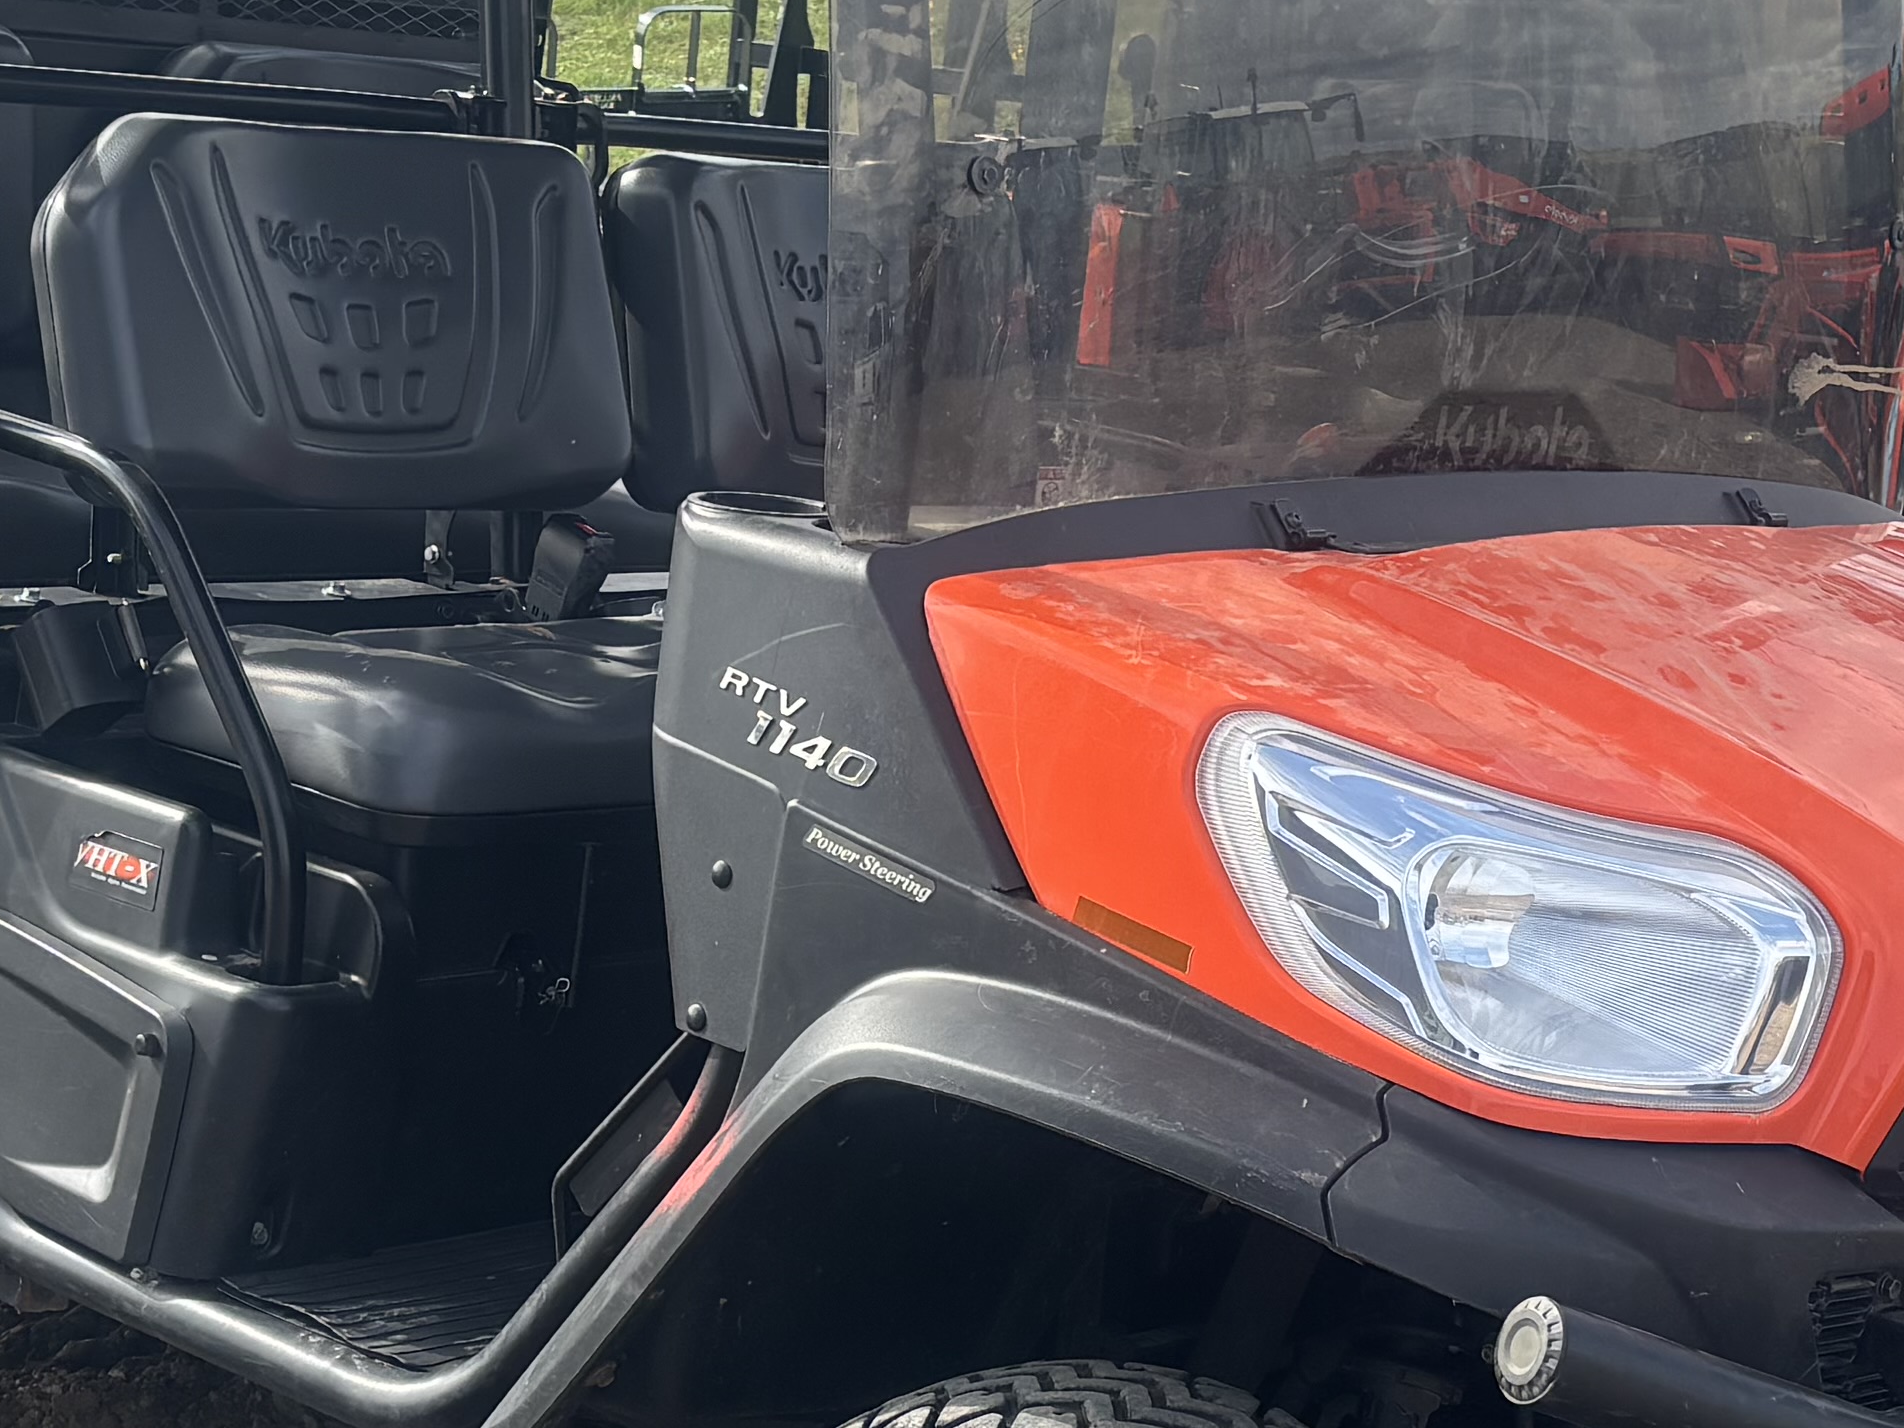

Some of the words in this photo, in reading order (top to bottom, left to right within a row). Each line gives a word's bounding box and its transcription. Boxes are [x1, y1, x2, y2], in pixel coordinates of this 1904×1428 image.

[258, 217, 452, 279] Kubota
[1434, 404, 1593, 469] Kubota
[719, 665, 808, 717] RTV
[746, 709, 879, 788] 1140
[804, 826, 861, 864] Power
[858, 853, 934, 904] Steering
